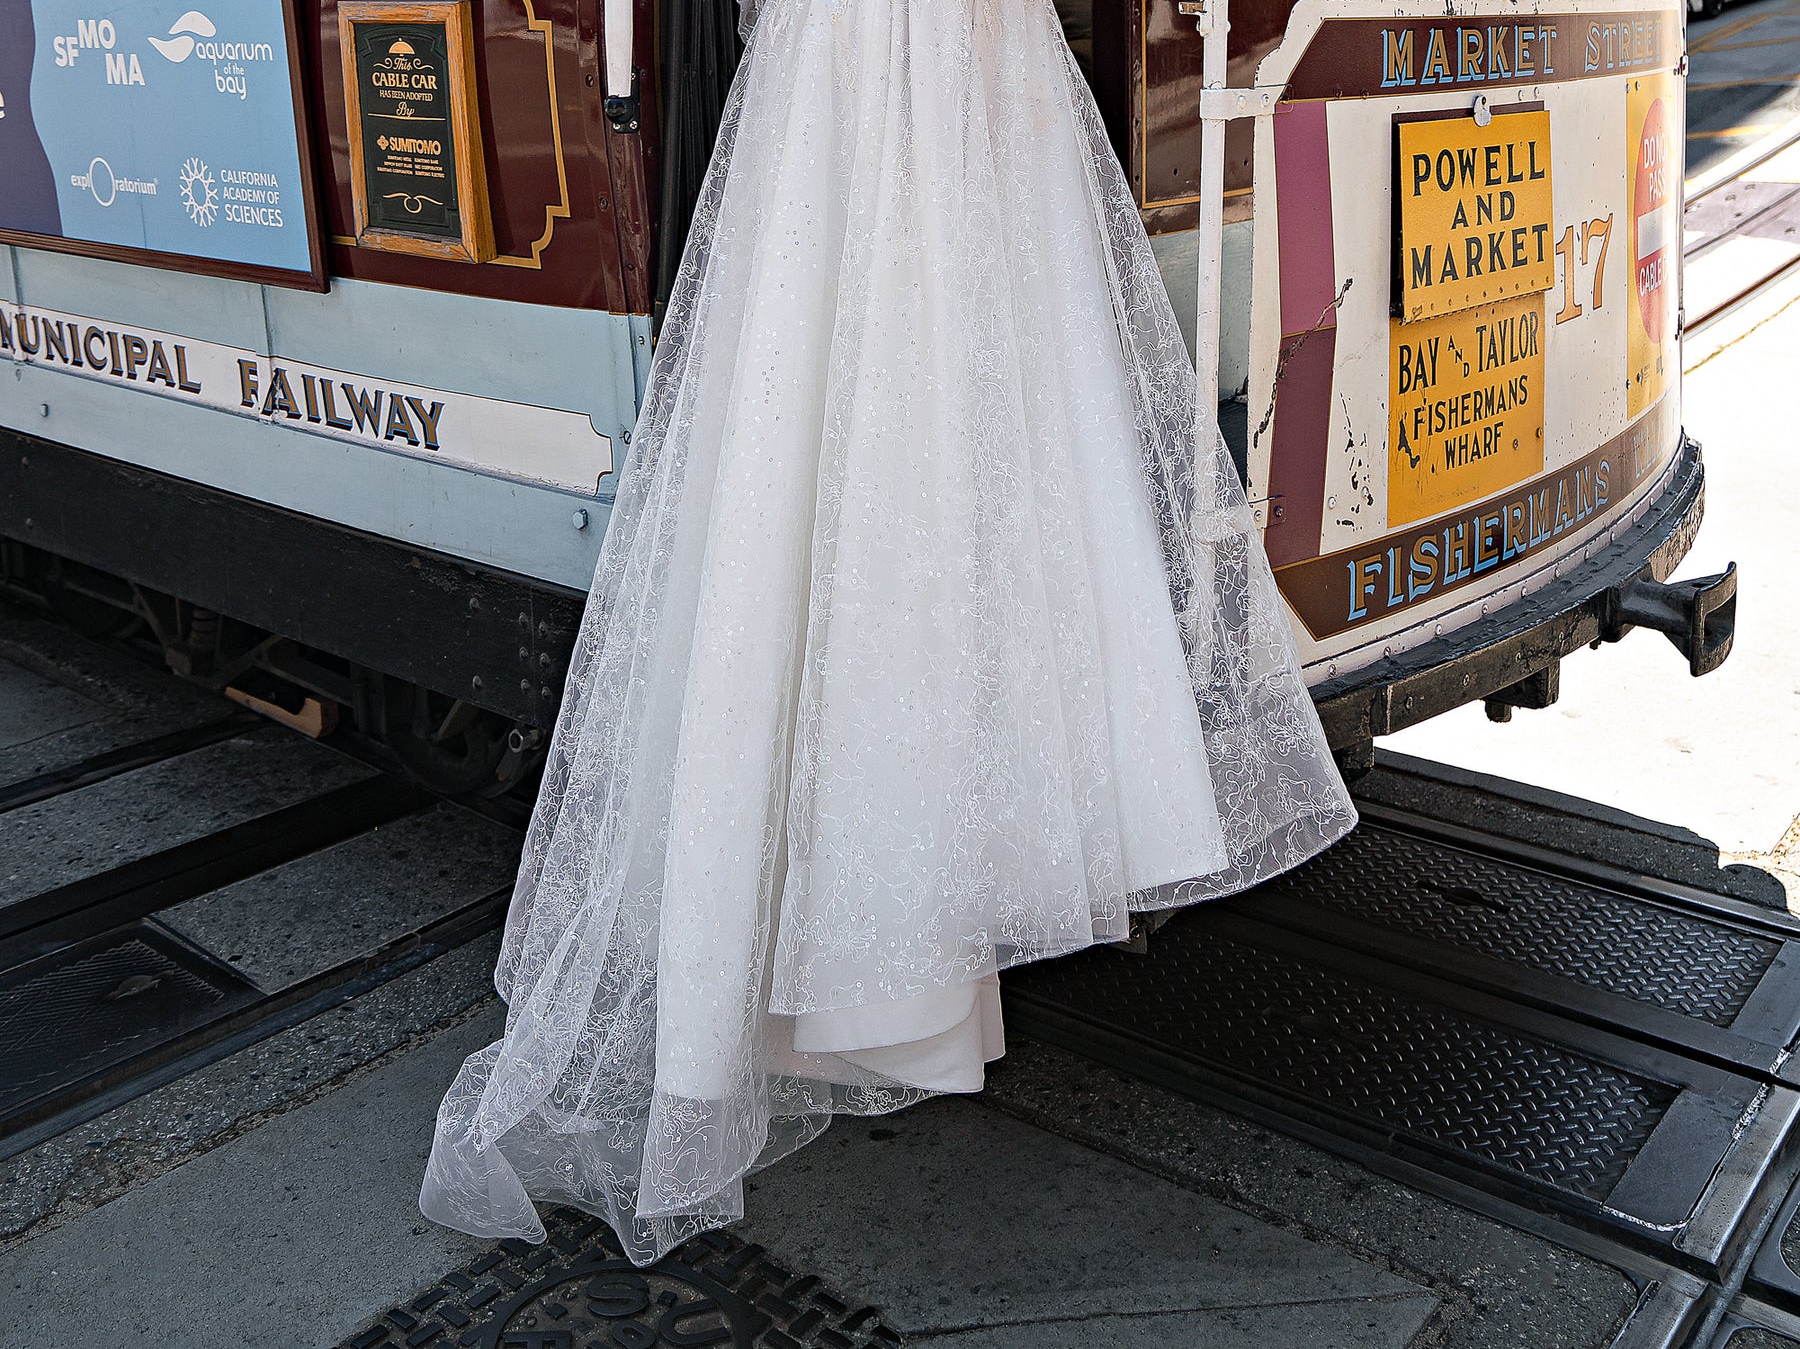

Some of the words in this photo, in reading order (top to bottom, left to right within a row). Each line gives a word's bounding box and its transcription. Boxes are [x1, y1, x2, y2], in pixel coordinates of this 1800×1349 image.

[195, 42, 274, 65] aquarium
[223, 62, 231, 74] of
[233, 62, 245, 75] the
[393, 57, 413, 71] This
[1380, 24, 1558, 88] MARKET
[214, 69, 247, 100] bay
[372, 72, 410, 88] CABLE
[411, 74, 438, 90] CAR
[380, 90, 392, 98] HAS
[392, 91, 406, 100] BEEN
[406, 92, 433, 102] ADOPTED
[396, 101, 415, 118] By
[389, 136, 442, 155] SUMITOMO
[1643, 137, 1655, 169] DO
[220, 169, 279, 188] CALIFORNIA
[1412, 141, 1545, 197] POWELL
[1649, 167, 1667, 203] PASS
[223, 186, 267, 204] ACADEMY
[267, 191, 280, 205] OF
[1451, 190, 1515, 230] AND
[225, 204, 284, 228] SCIENCES
[1411, 223, 1548, 289] MARKET
[1555, 212, 1613, 325] 17
[1639, 262, 1662, 298] CABLE
[1398, 336, 1440, 395] BAY
[1447, 335, 1471, 378] AND
[1475, 311, 1539, 373] TAYLOR
[1413, 374, 1529, 441] FISHERMANS
[1444, 421, 1504, 470] WHARF
[1347, 454, 1611, 622] FISHERMANS
